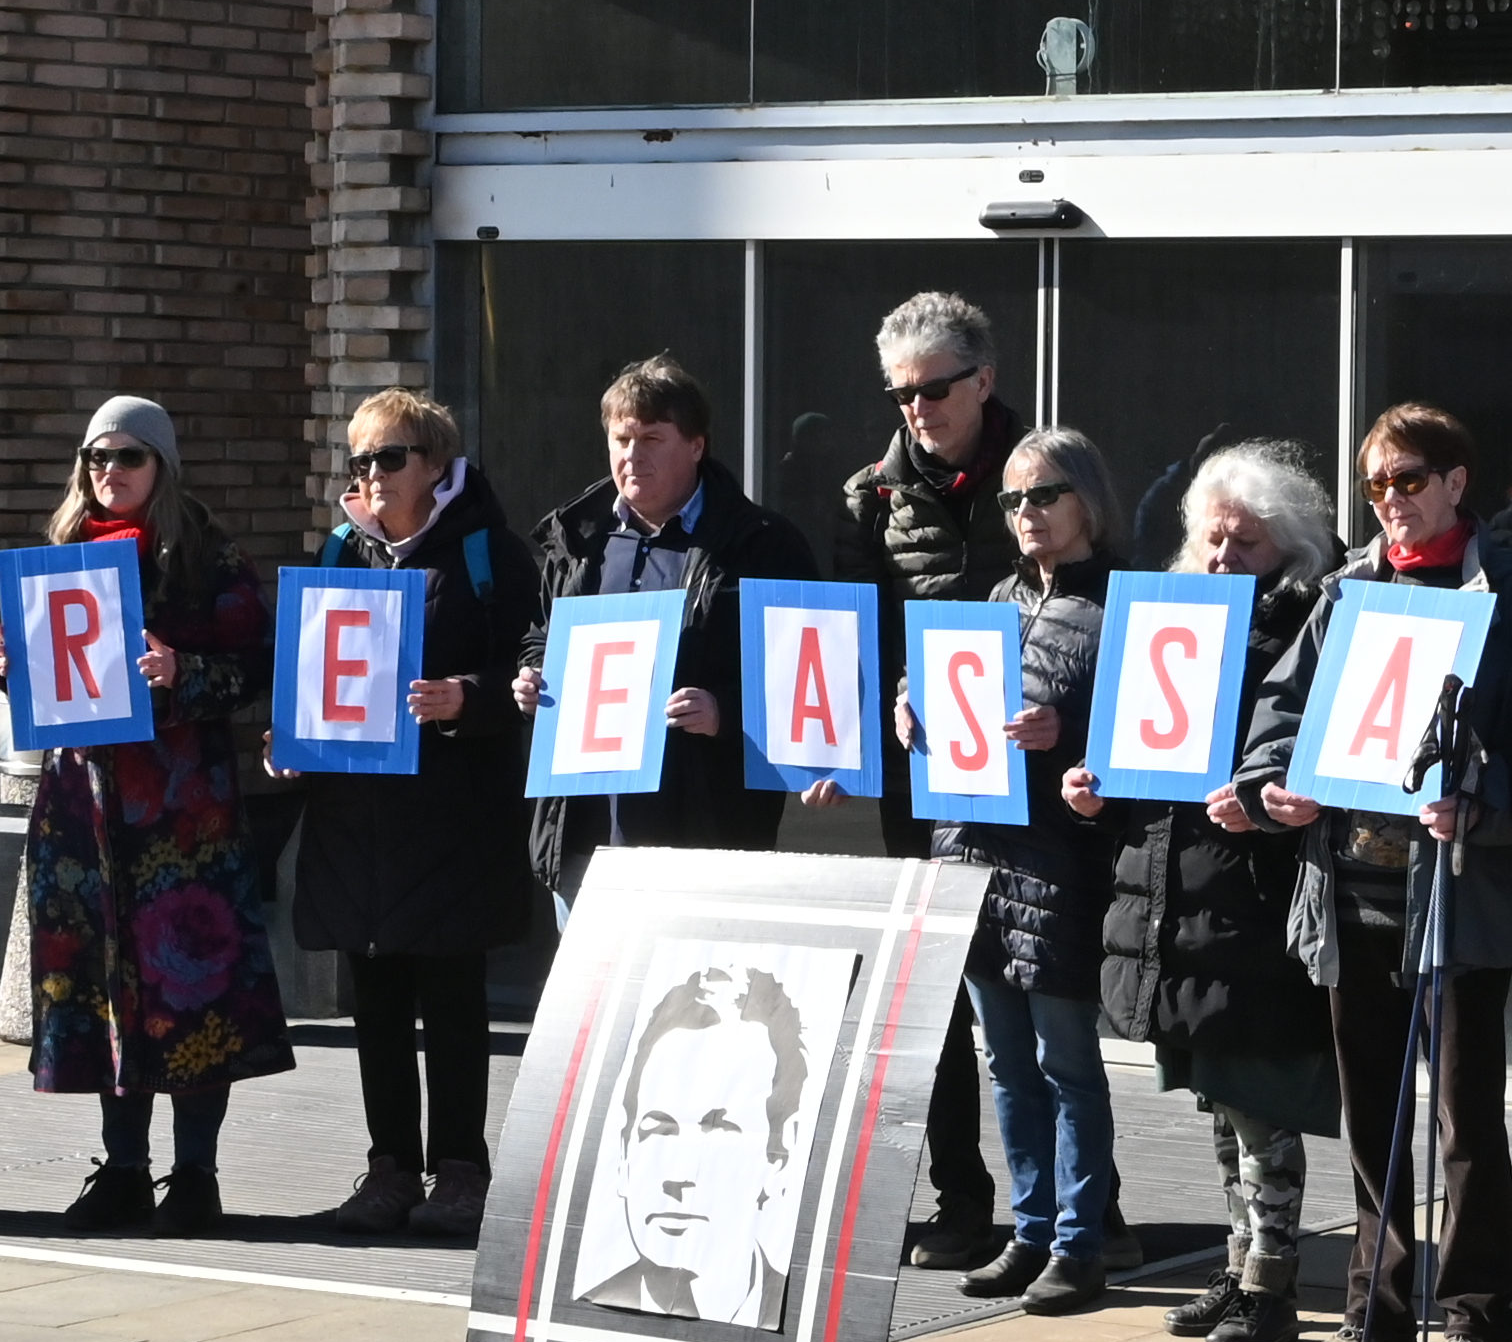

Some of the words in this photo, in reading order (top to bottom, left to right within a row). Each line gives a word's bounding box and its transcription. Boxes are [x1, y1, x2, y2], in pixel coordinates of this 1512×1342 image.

[48, 589, 101, 701] R
[322, 609, 370, 722] E
[582, 641, 635, 753] E
[790, 626, 838, 746] A
[1139, 626, 1198, 750] S
[1349, 637, 1414, 760] A
[948, 650, 989, 772] S
